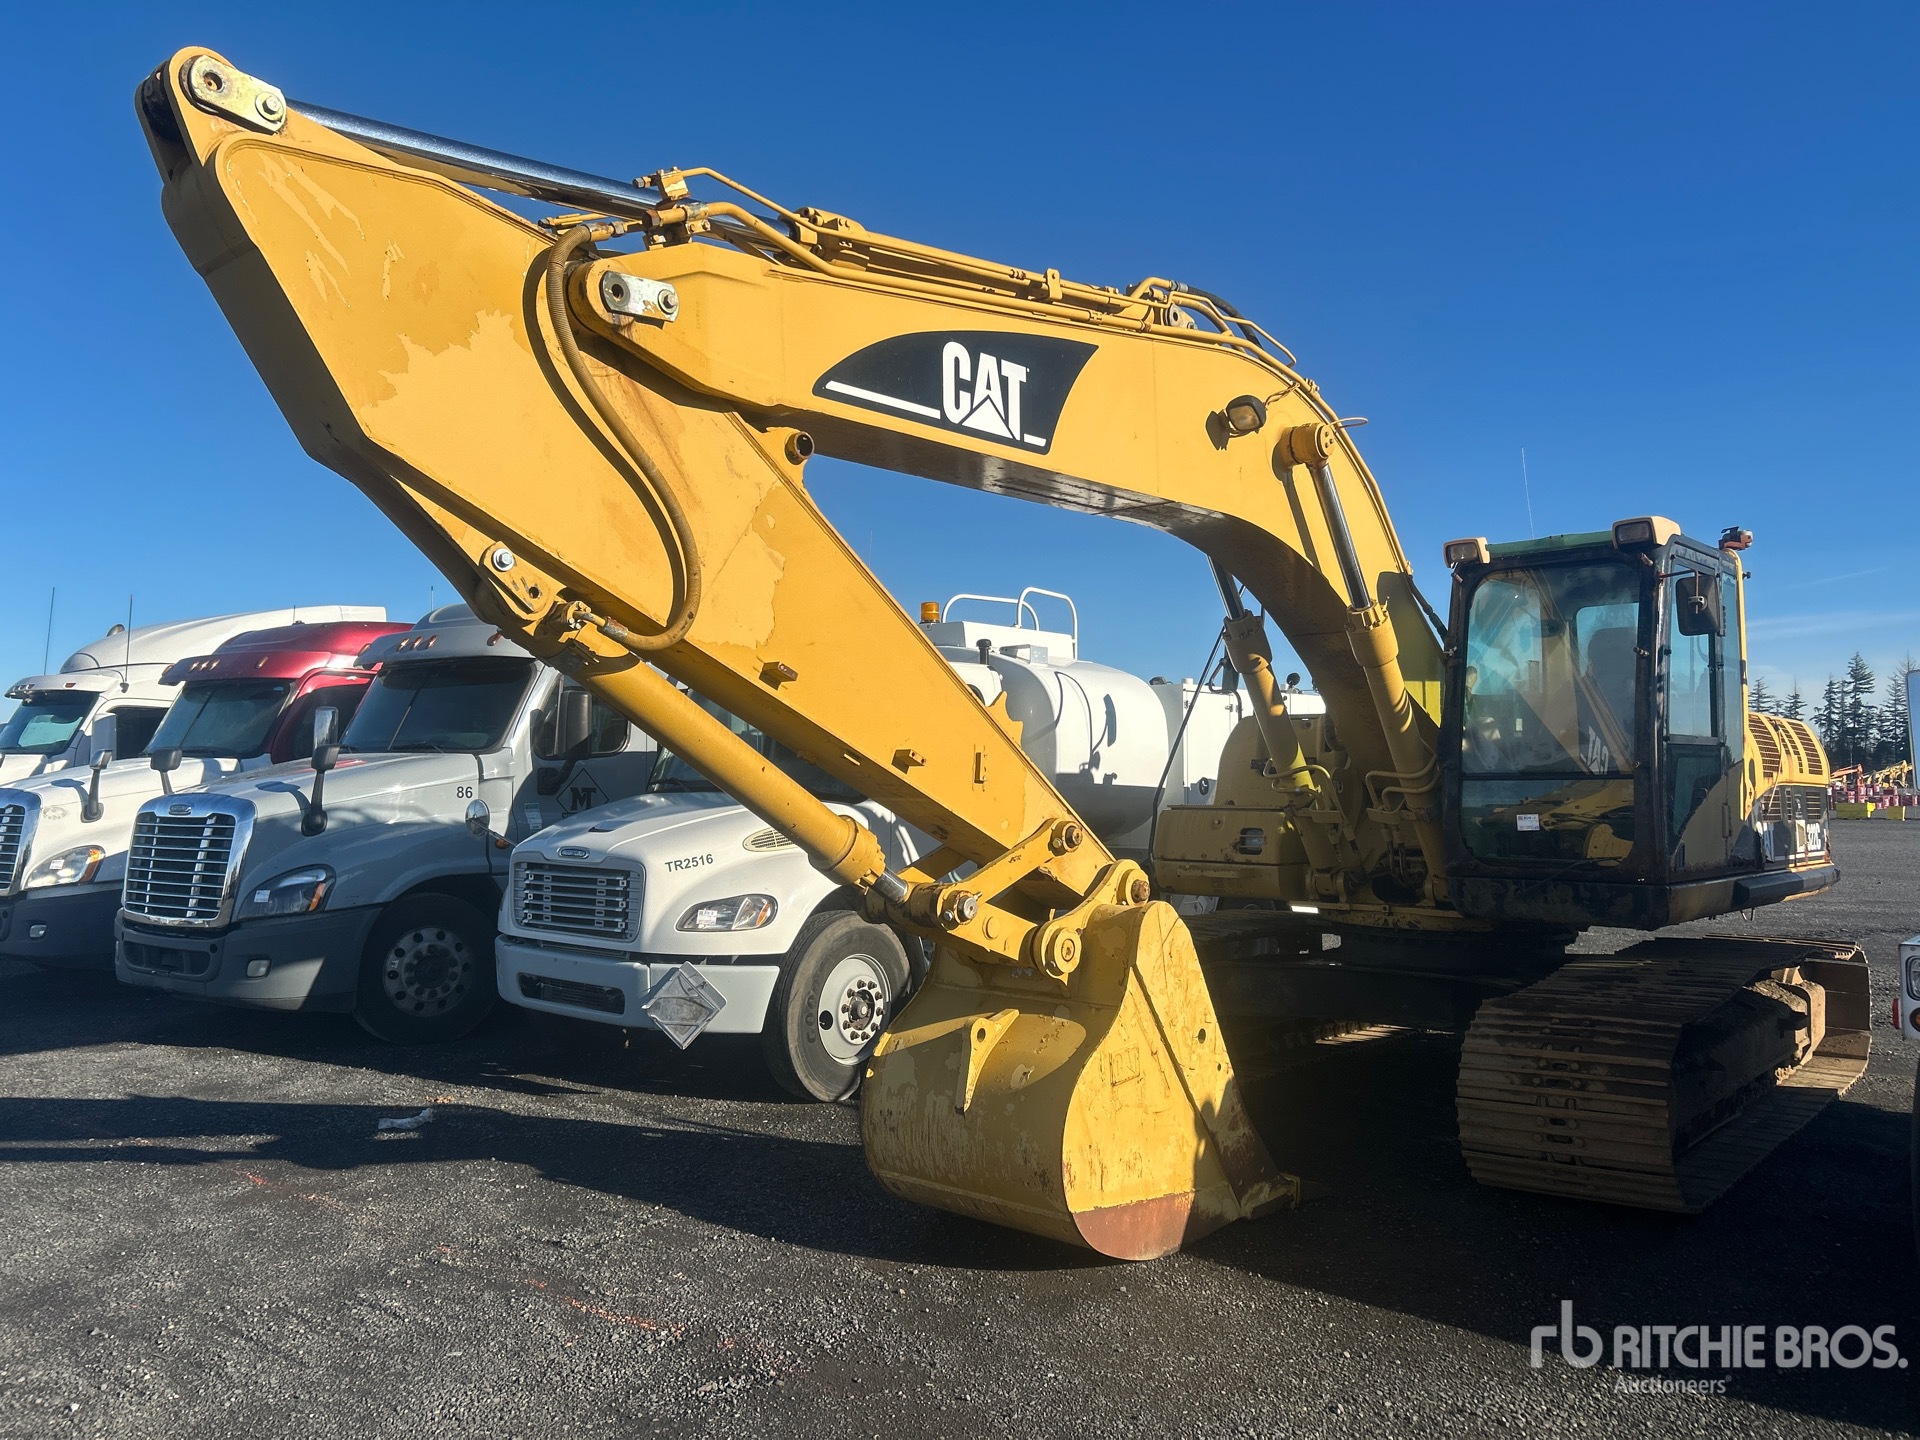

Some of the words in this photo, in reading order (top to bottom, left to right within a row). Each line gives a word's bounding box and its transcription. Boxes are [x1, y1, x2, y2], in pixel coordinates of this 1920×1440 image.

[942, 341, 1028, 441] CAT
[456, 786, 473, 799] 86
[664, 853, 714, 873] TR2516
